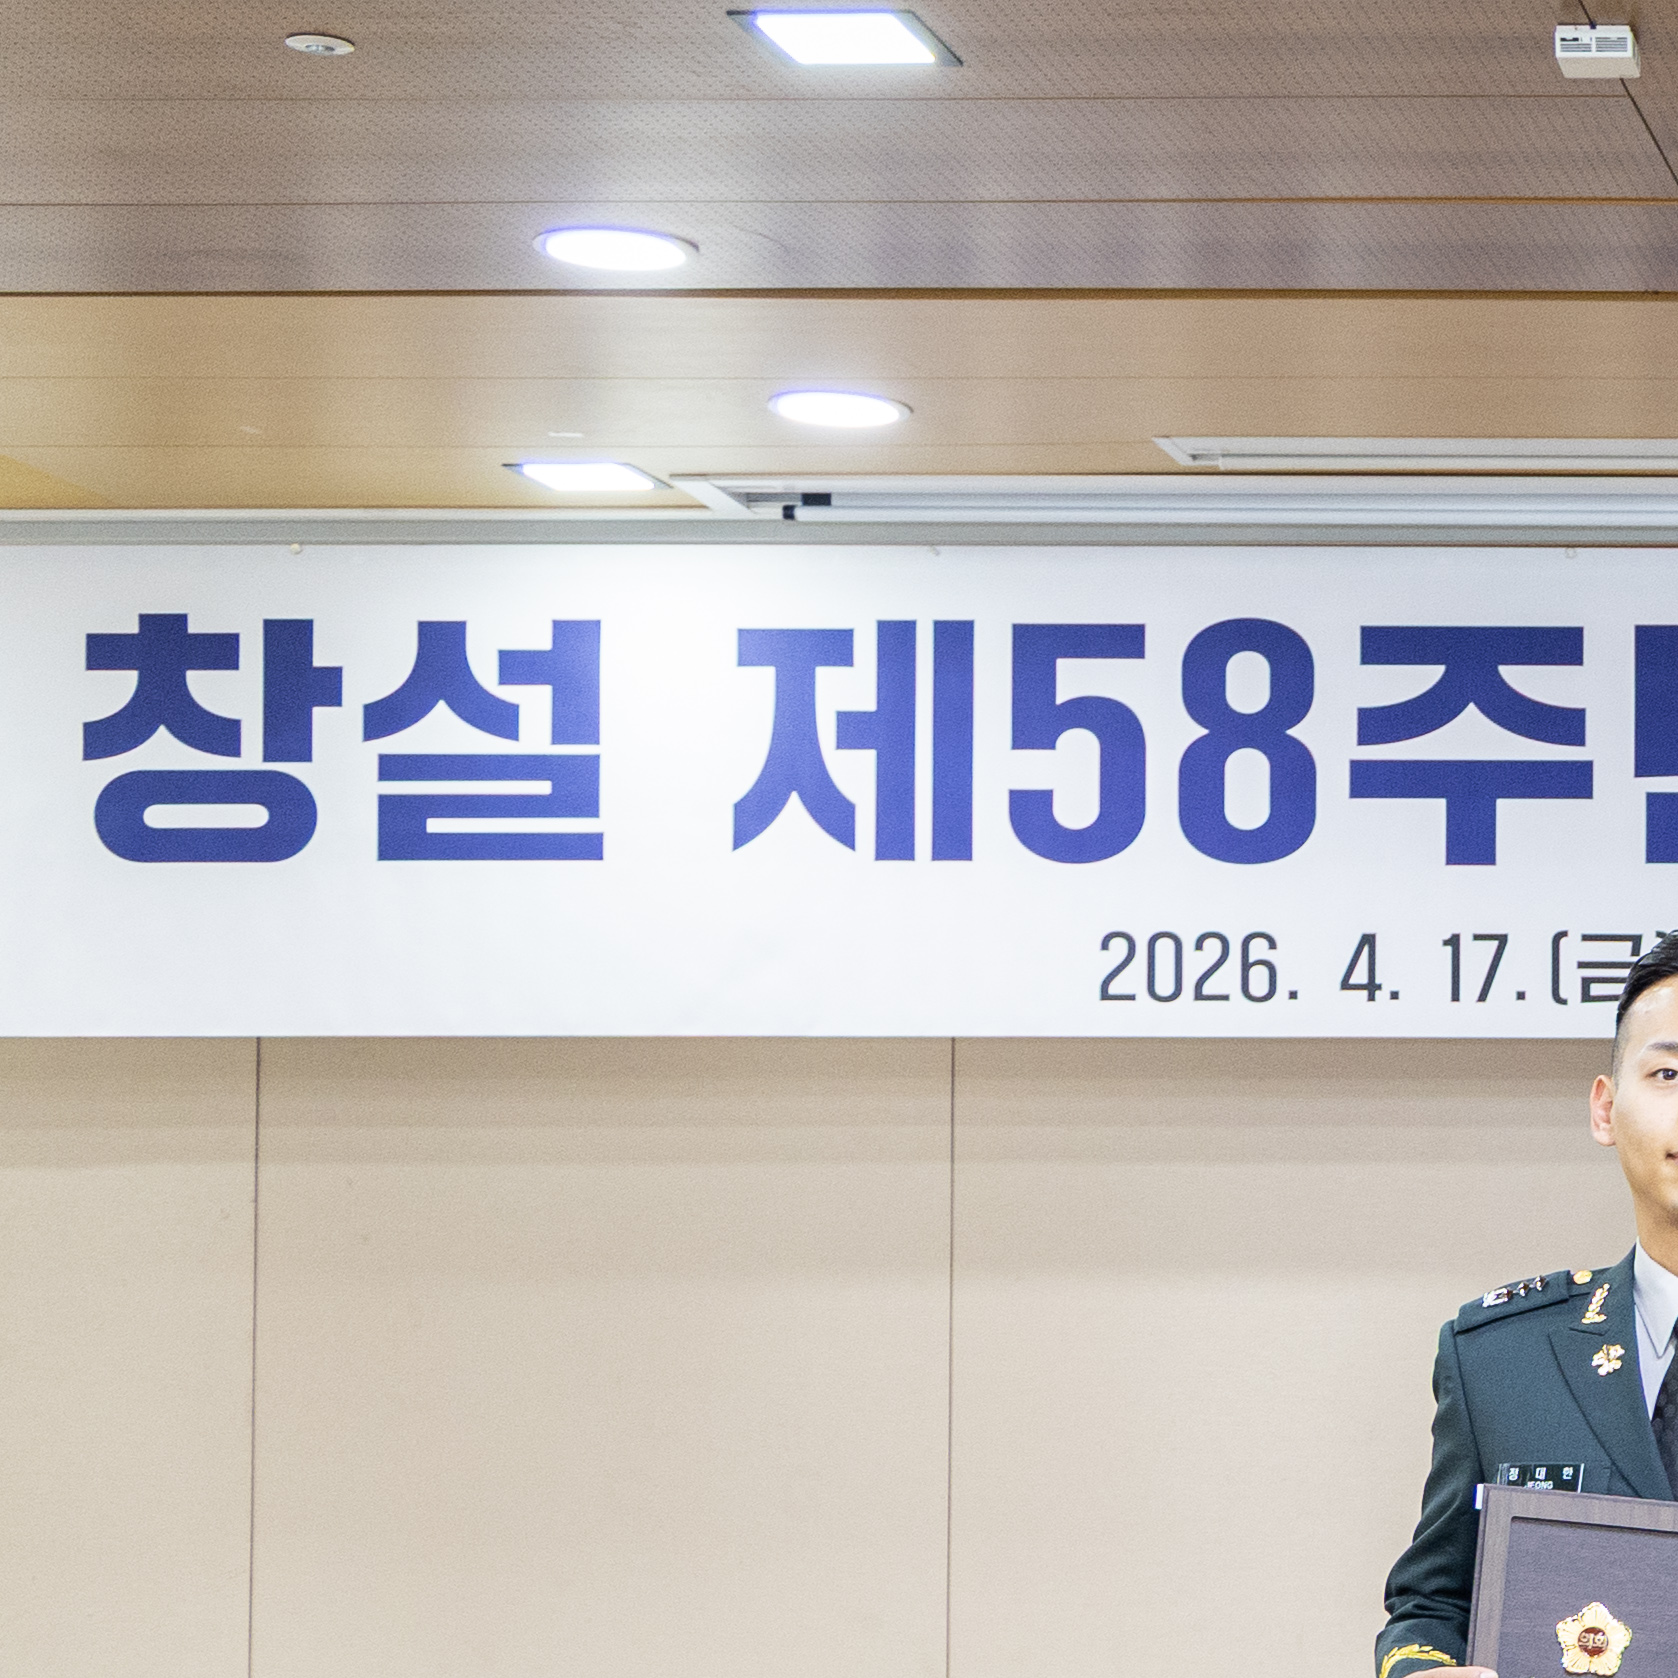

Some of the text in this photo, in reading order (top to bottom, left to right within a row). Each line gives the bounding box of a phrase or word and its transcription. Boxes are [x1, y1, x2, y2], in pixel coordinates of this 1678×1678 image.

[82, 612, 605, 864] 창설
[1099, 930, 1299, 1004] 2026.
[1340, 932, 1400, 1003] 4.
